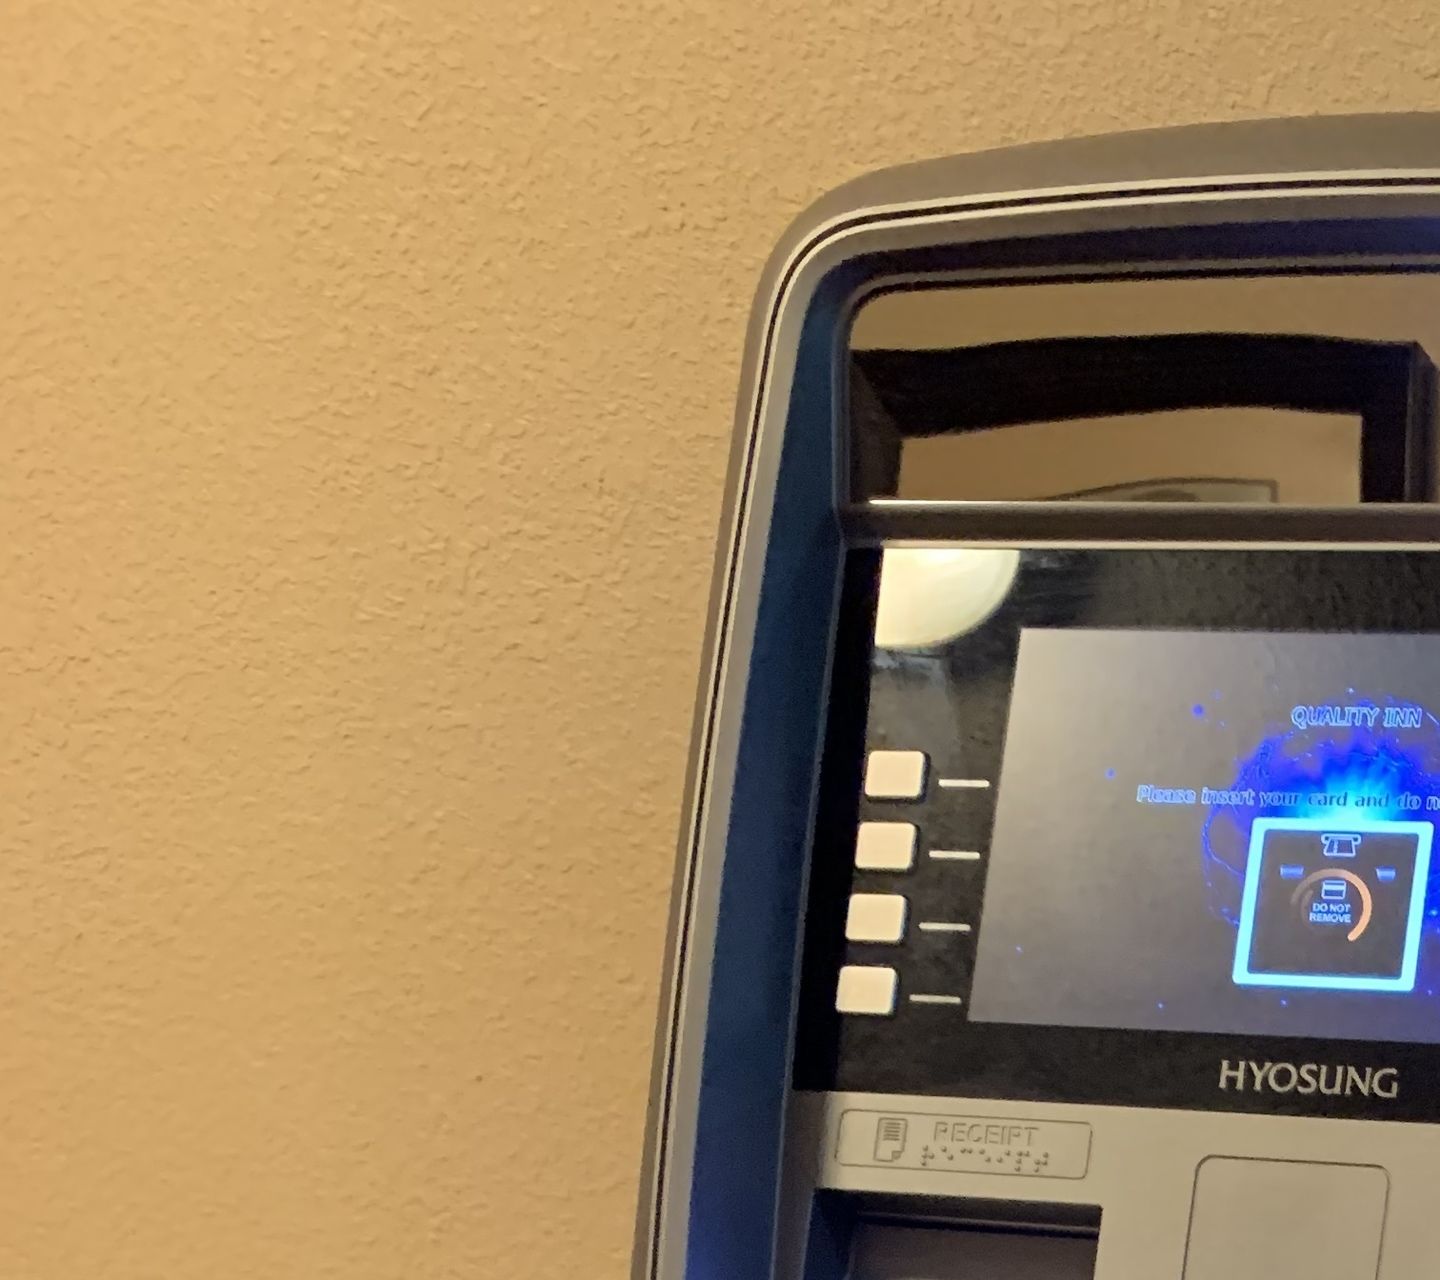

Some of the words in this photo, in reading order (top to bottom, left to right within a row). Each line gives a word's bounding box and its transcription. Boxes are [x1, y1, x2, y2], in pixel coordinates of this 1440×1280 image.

[1291, 705, 1379, 729] QUALITY
[1383, 707, 1423, 728] INN
[1136, 784, 1197, 804] Please
[1201, 787, 1255, 806] insert
[1259, 792, 1303, 808] your
[1309, 791, 1348, 807] card
[1355, 792, 1390, 808] and
[1399, 792, 1421, 810] do
[1309, 913, 1352, 923] REMOVE
[1312, 902, 1329, 913] DO
[1329, 903, 1352, 914] NOT
[1218, 1059, 1399, 1099] HYOSUNG
[933, 1121, 1040, 1146] RECEIPT
